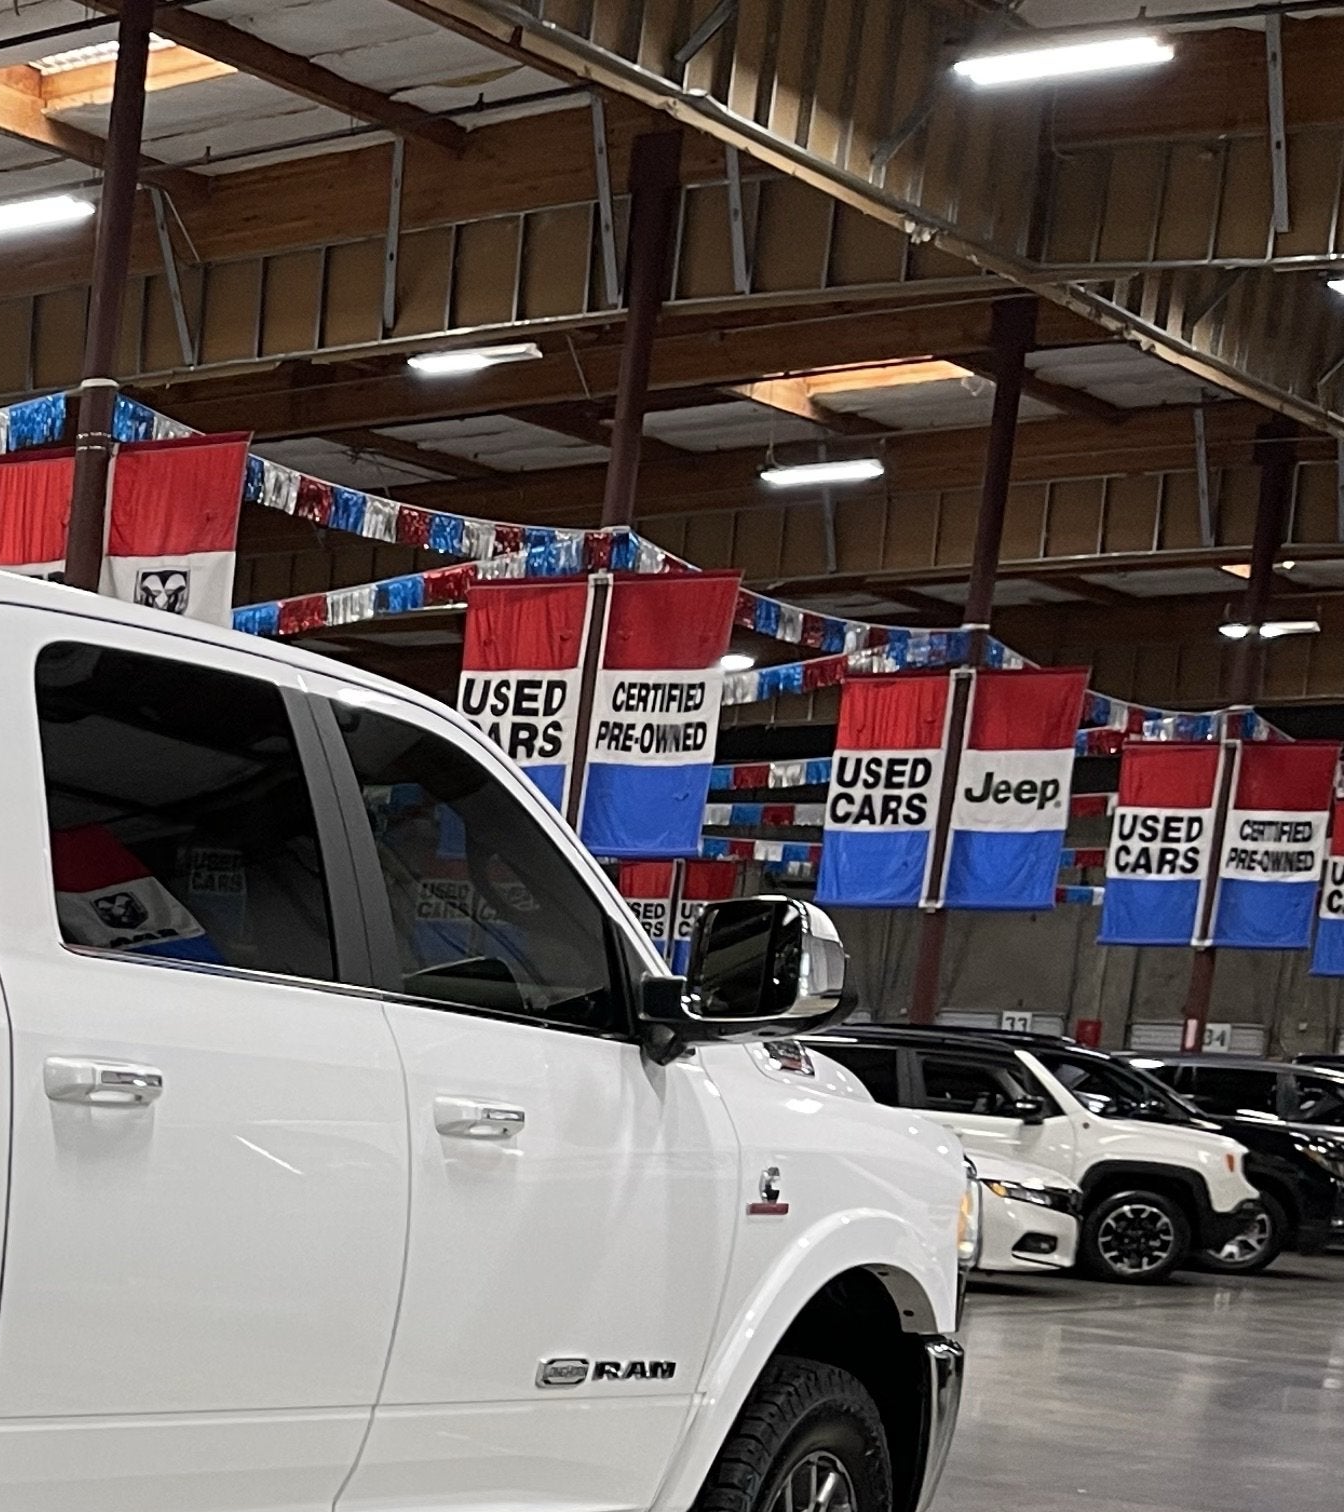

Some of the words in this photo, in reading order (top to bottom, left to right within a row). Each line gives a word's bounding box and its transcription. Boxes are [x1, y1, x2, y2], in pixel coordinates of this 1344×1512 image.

[462, 678, 567, 717] USED
[612, 681, 706, 713] CERTIFIED
[595, 720, 708, 754] PRE-OWNED
[836, 756, 933, 790] USED
[964, 772, 1061, 811] Jeep
[829, 792, 928, 826] CARS
[1118, 814, 1204, 843] USED
[1115, 845, 1201, 875] CARS
[592, 1360, 677, 1381] RAM
